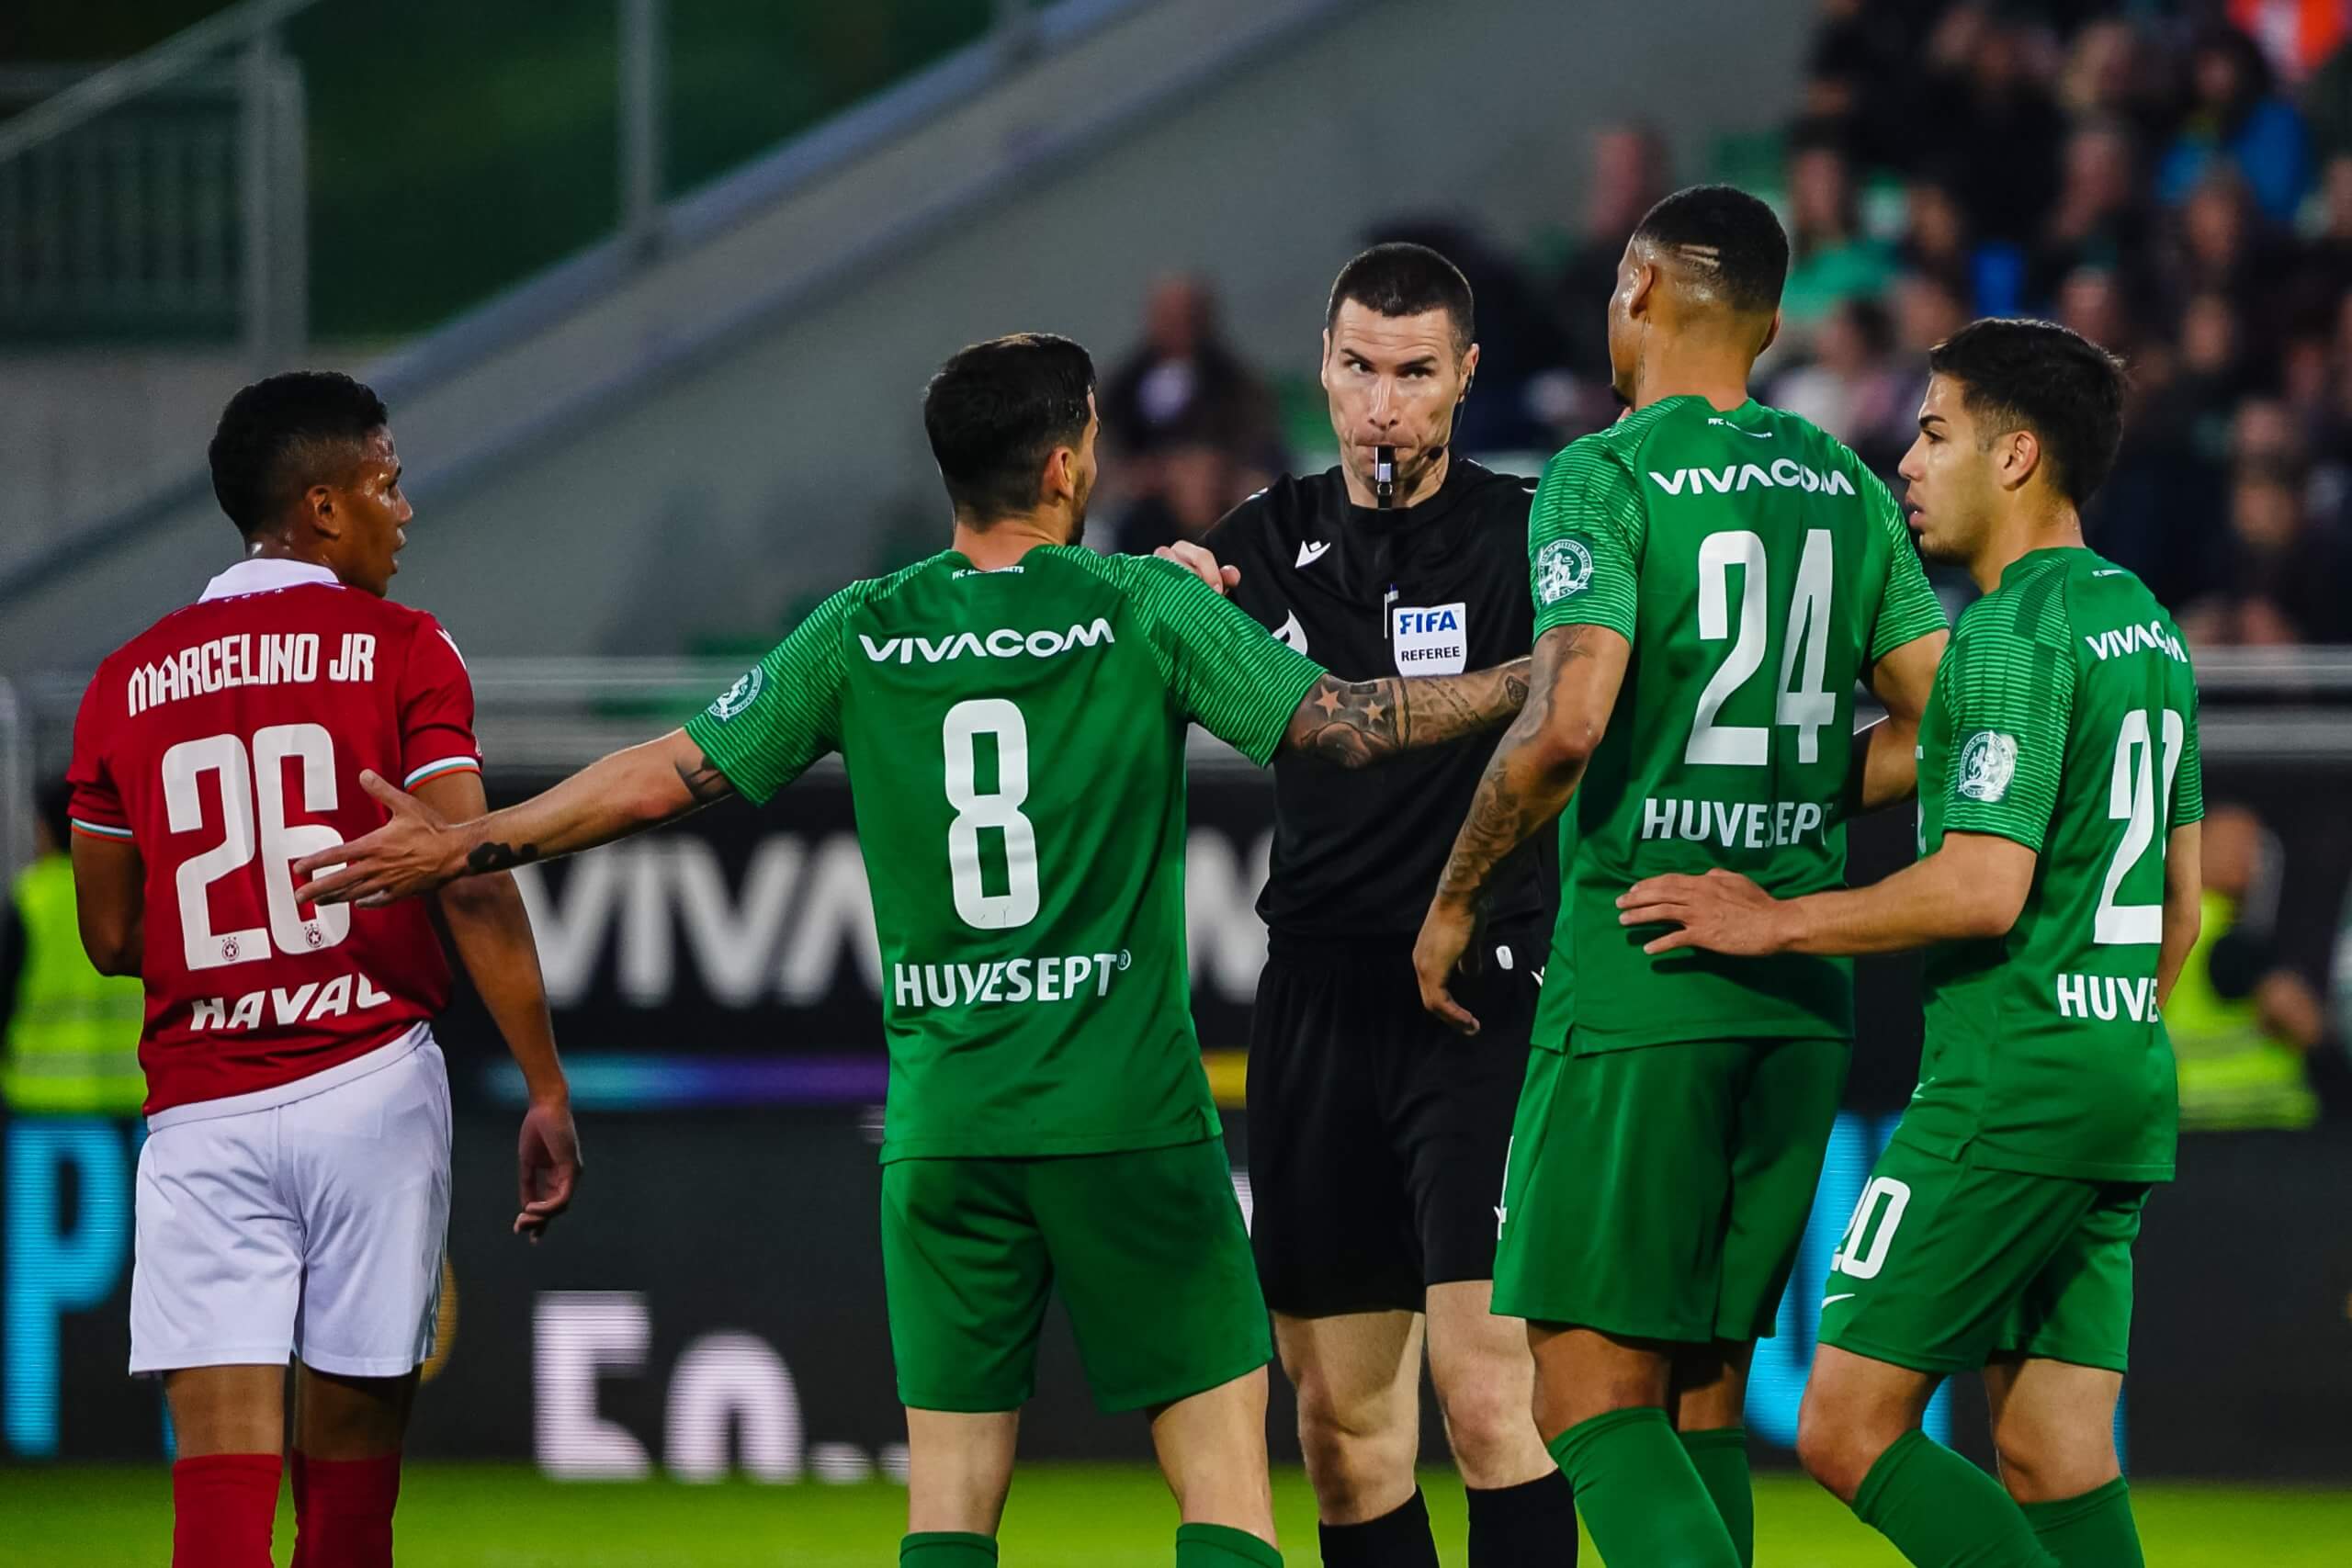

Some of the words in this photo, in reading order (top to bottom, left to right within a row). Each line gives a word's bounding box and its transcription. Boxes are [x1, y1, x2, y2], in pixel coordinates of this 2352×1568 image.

[1648, 458, 1855, 495] VIVACOM
[858, 617, 1114, 664] VIVACOM
[1399, 610, 1458, 635] FIFA
[1684, 529, 1836, 766] 24
[128, 634, 320, 716] MARCELINO
[328, 633, 376, 682] JR
[1401, 646, 1460, 661] REFEREE
[943, 699, 1039, 930] 8
[161, 723, 350, 971] 26
[189, 973, 391, 1032] HAVAL
